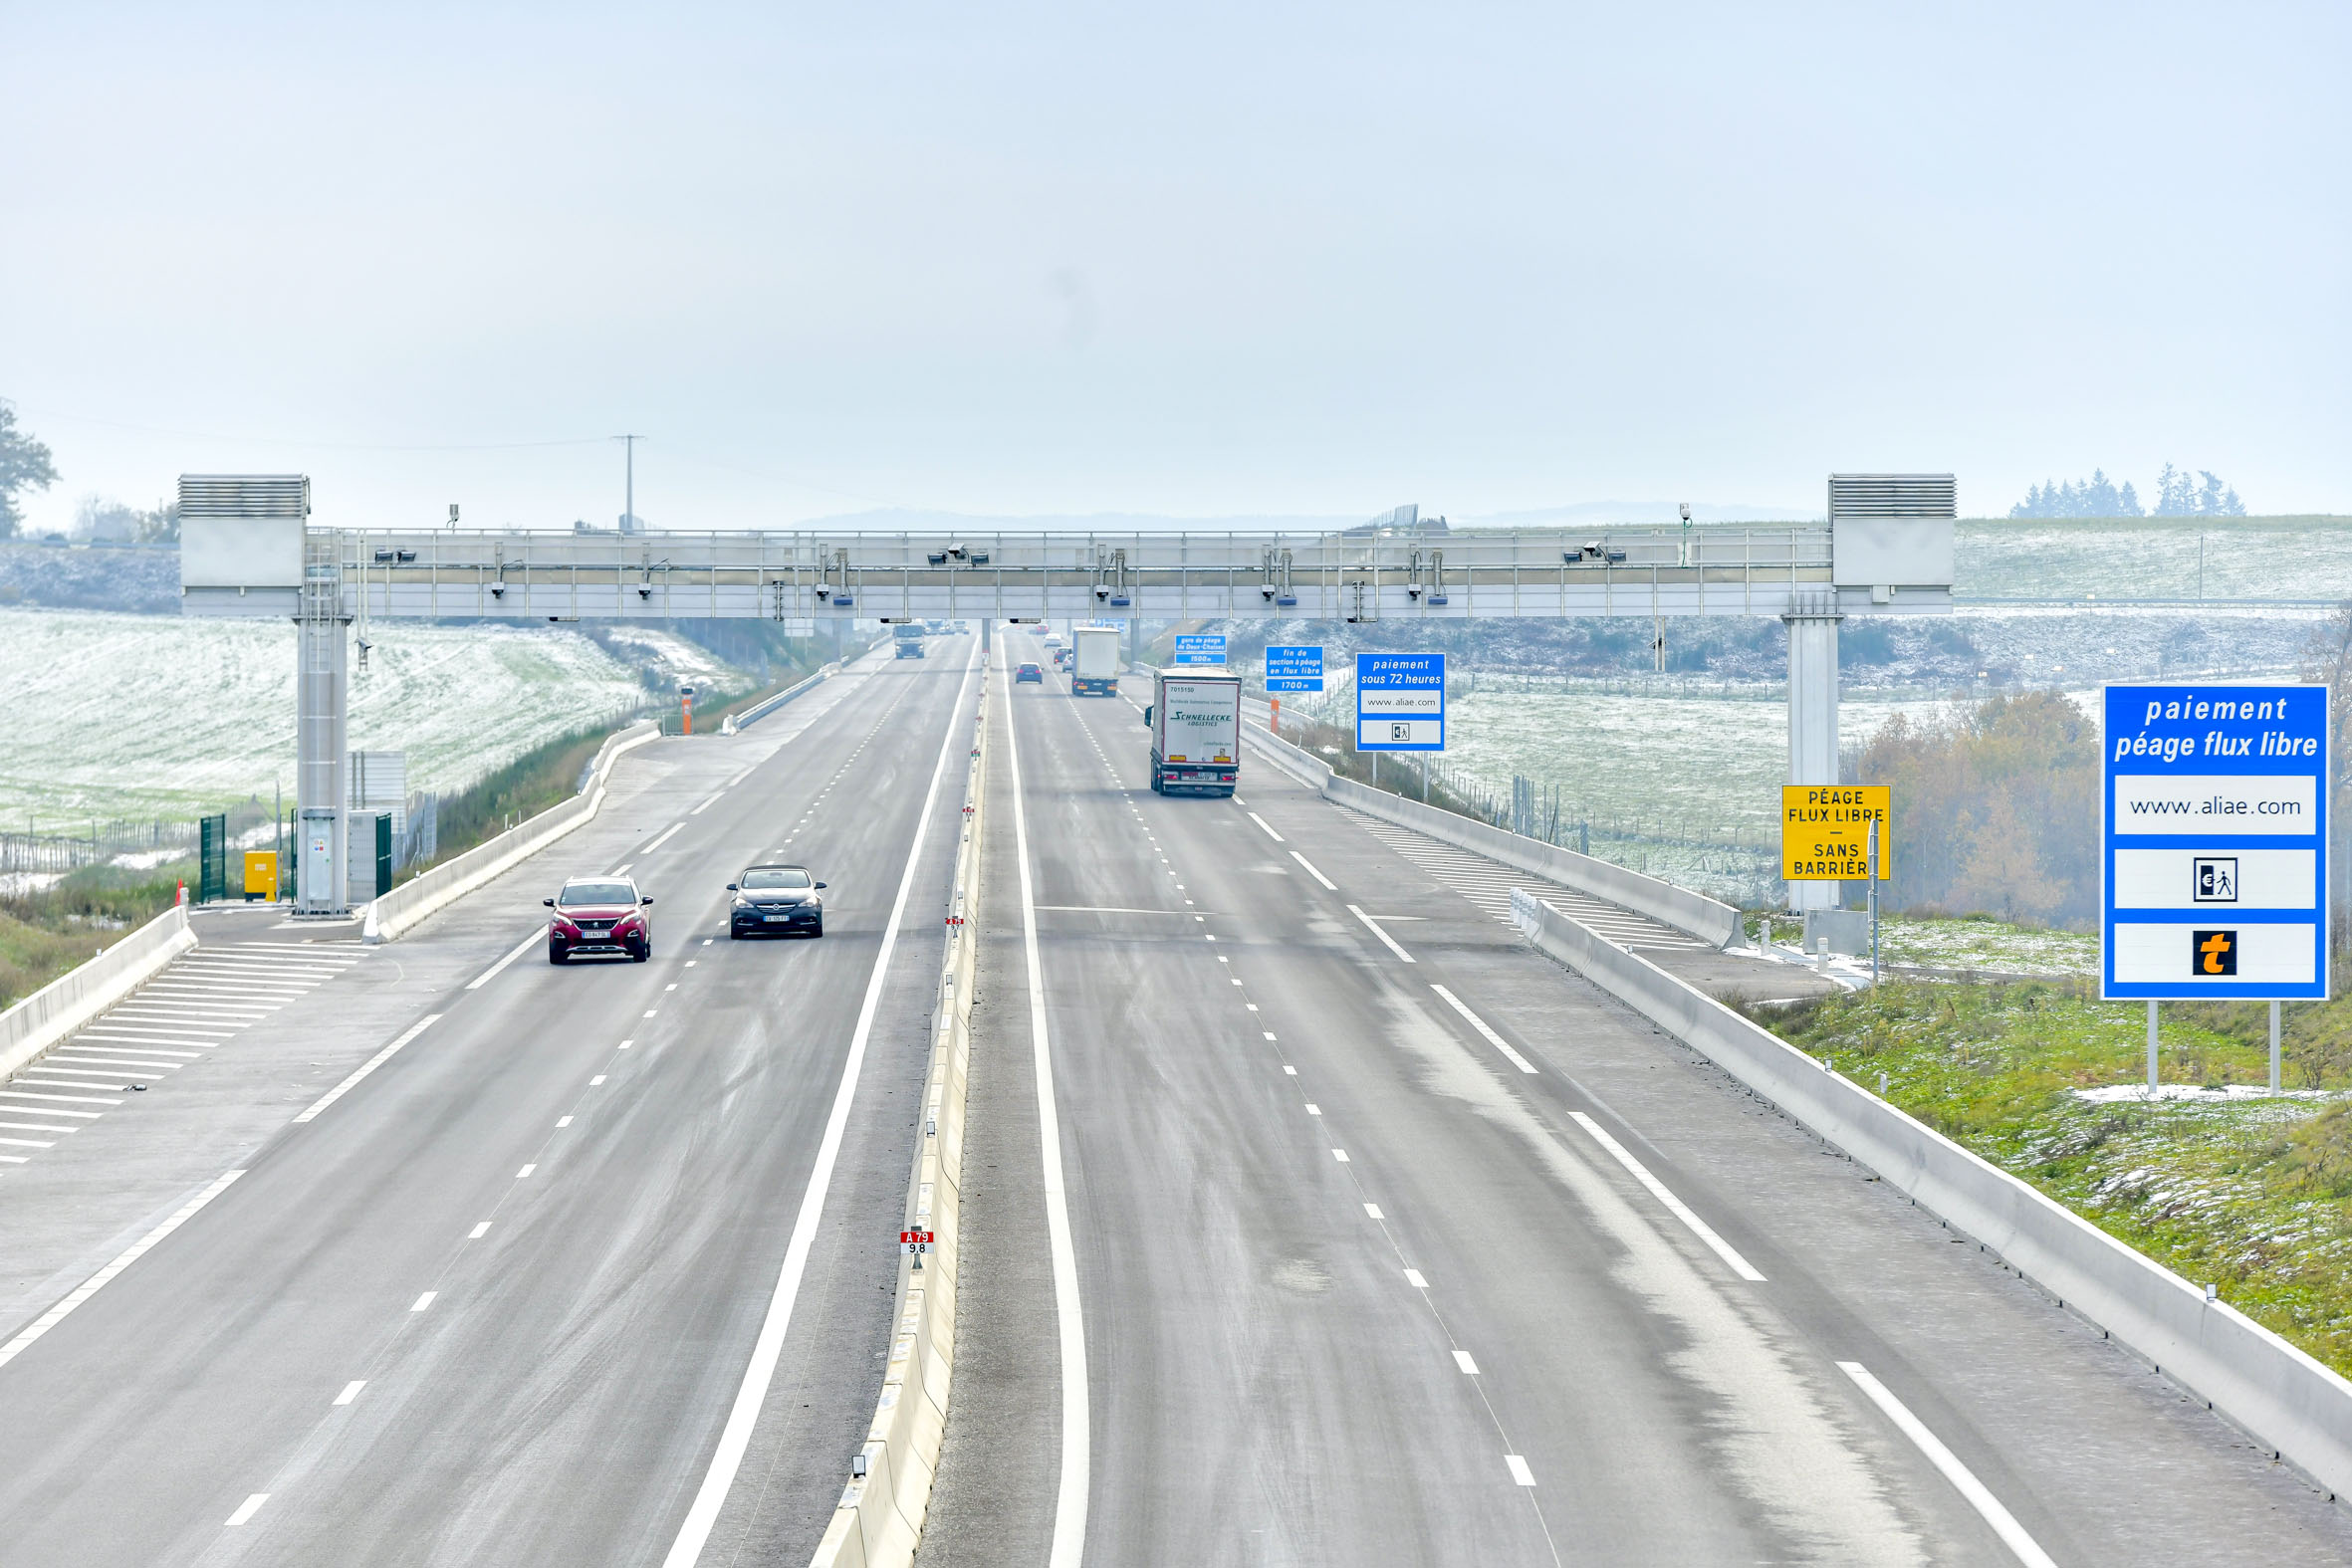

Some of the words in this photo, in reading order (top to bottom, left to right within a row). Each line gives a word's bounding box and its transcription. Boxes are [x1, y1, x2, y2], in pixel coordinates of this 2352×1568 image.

[1283, 648, 1294, 657] fin
[1299, 658, 1321, 667] péage
[1372, 658, 1430, 671] paiement
[1361, 675, 1386, 684] sous
[1389, 673, 1403, 684] 72
[1405, 673, 1441, 684] heures
[2145, 695, 2286, 726] paiement
[2114, 731, 2195, 763] péage
[2204, 731, 2253, 757] flux
[2259, 731, 2318, 757] libre
[1808, 787, 1864, 804] PÉAGE
[2130, 795, 2301, 814] www.aliae.com
[1788, 808, 1829, 822] FLUX
[1835, 808, 1884, 822] LIBRE
[1814, 843, 1859, 857] SANS
[1793, 858, 1868, 874] BARRIÈR
[906, 1232, 913, 1242] A
[916, 1232, 929, 1242] 79
